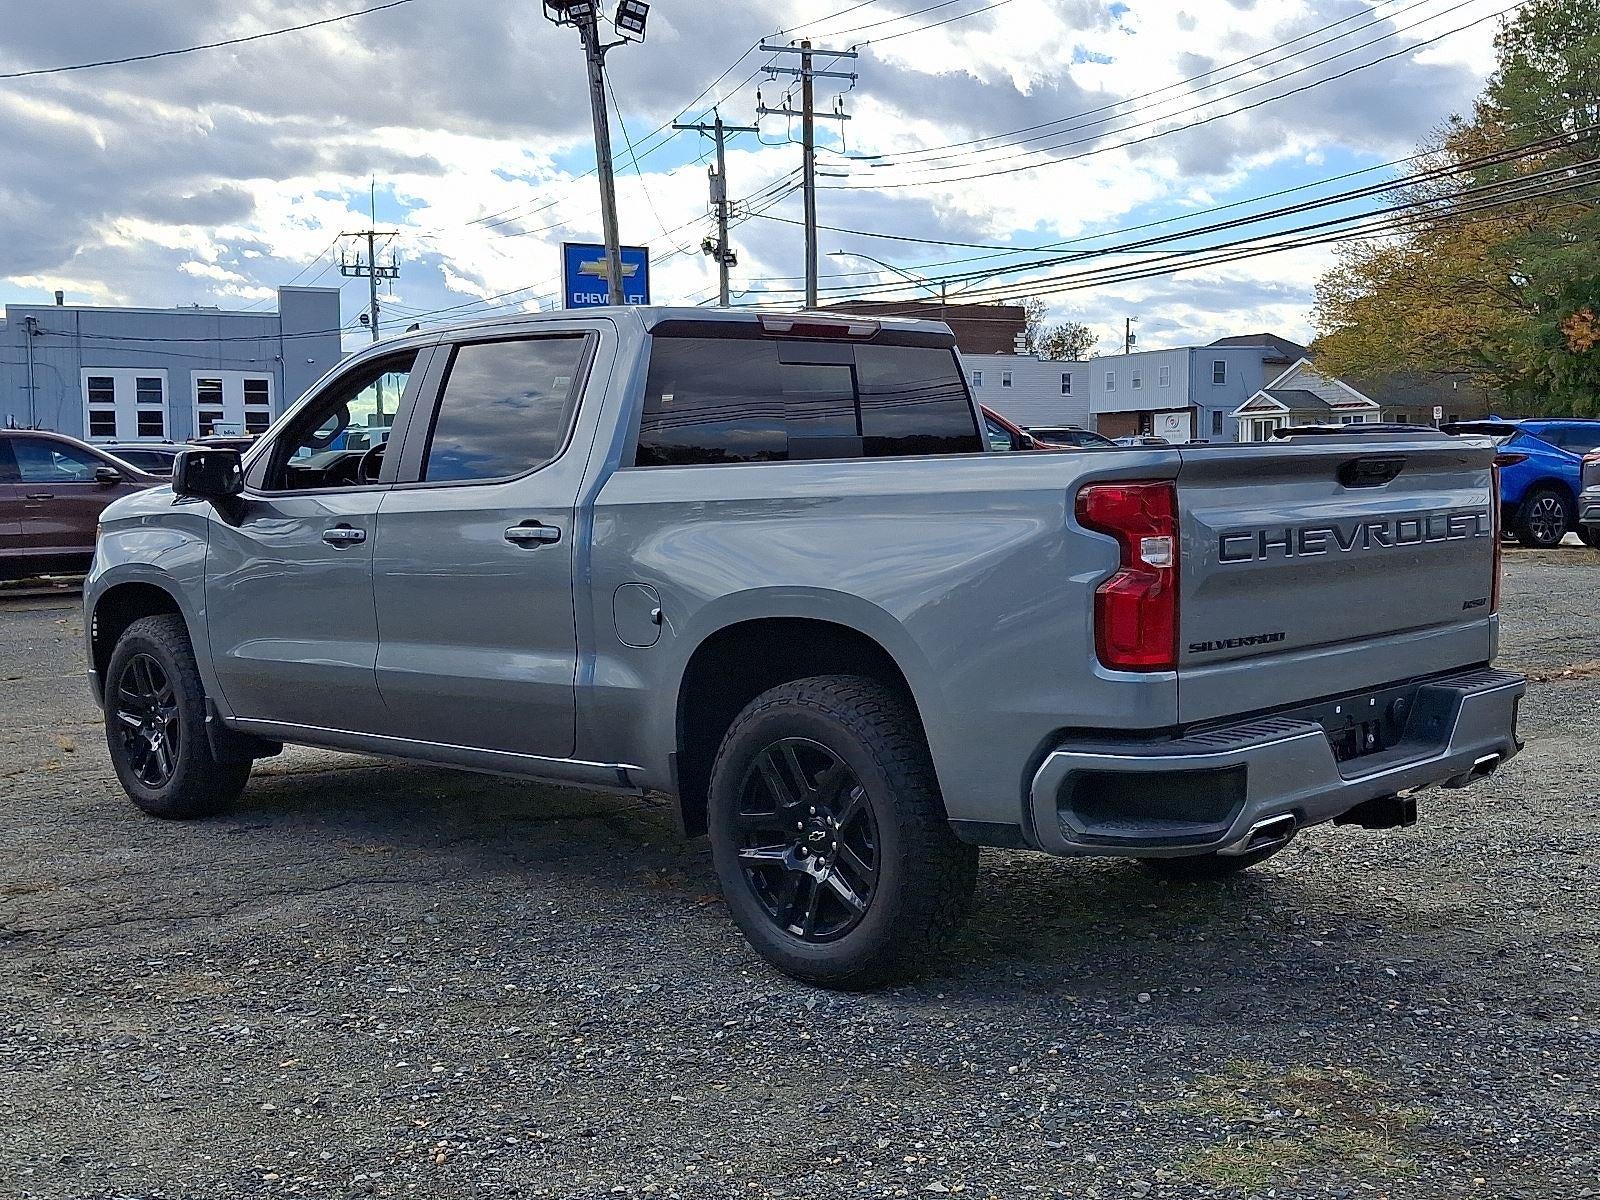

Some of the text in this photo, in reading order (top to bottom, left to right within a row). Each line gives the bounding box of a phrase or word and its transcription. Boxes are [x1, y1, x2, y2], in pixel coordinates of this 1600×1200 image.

[573, 292, 644, 305] CHEVLET
[1218, 509, 1489, 564] CHEVROLET
[1188, 632, 1286, 653] SILVERADO
